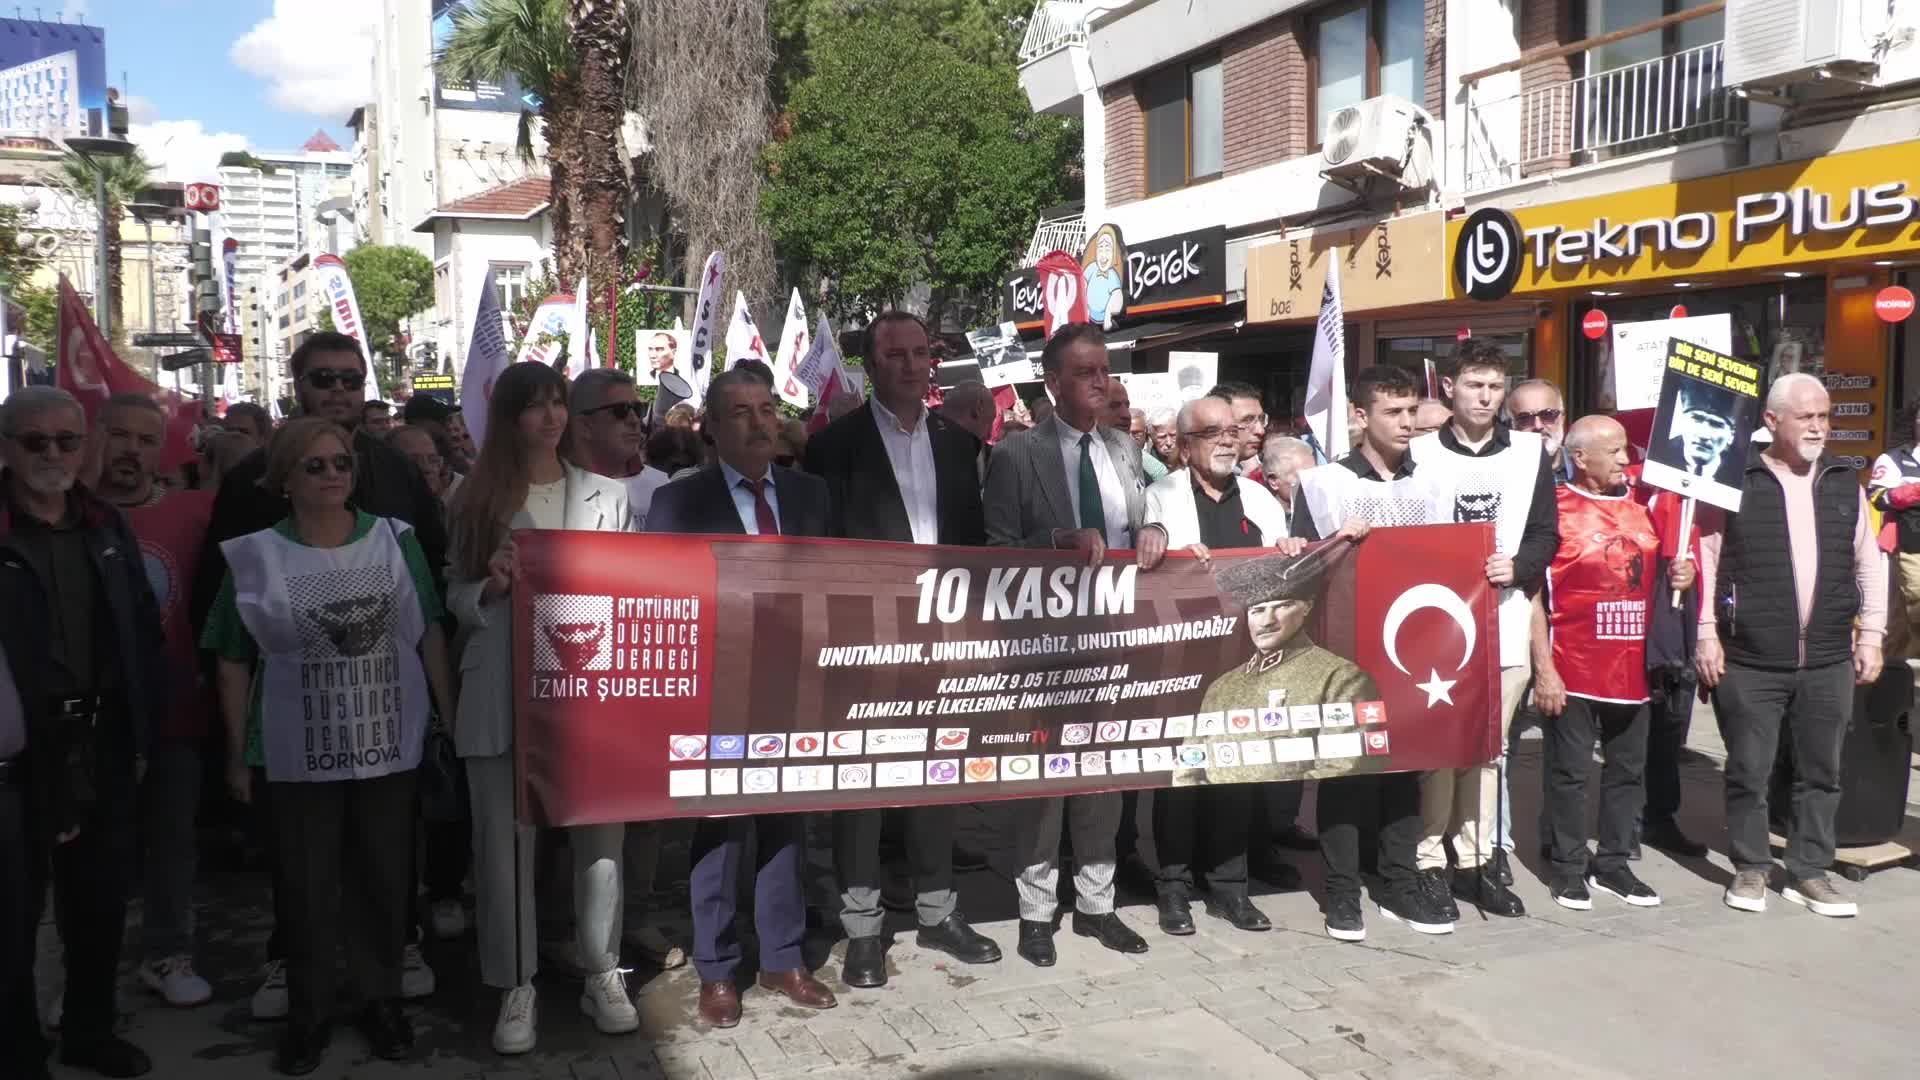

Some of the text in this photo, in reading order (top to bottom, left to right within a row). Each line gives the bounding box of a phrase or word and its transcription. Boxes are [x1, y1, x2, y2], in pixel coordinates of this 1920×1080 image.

[1524, 182, 1912, 268] Tekno Plus
[1686, 362, 1701, 376] DE
[618, 595, 699, 620] ATATÜRKÇÜ
[915, 564, 1137, 624] 10 KASIM
[617, 620, 698, 645] DÜŞÜNCE
[817, 643, 930, 667] UNUTMADIK,
[1077, 615, 1238, 650] UNUTTURMAYACAĞIZ
[617, 646, 697, 670] DERNEĞİ
[533, 674, 697, 702] İZMİR ŞUBELERİ
[937, 673, 1009, 694] KALBİMİZ
[1046, 670, 1062, 686] TE
[1062, 665, 1107, 684] DURSA
[1110, 664, 1129, 679] DA
[846, 674, 1203, 720] ATAMIZA VE İLKELERİNE İNANCIMIZ HİÇ BİTMEYECEK!
[1031, 730, 1048, 745] TV
[306, 745, 401, 771] BORNOVA
